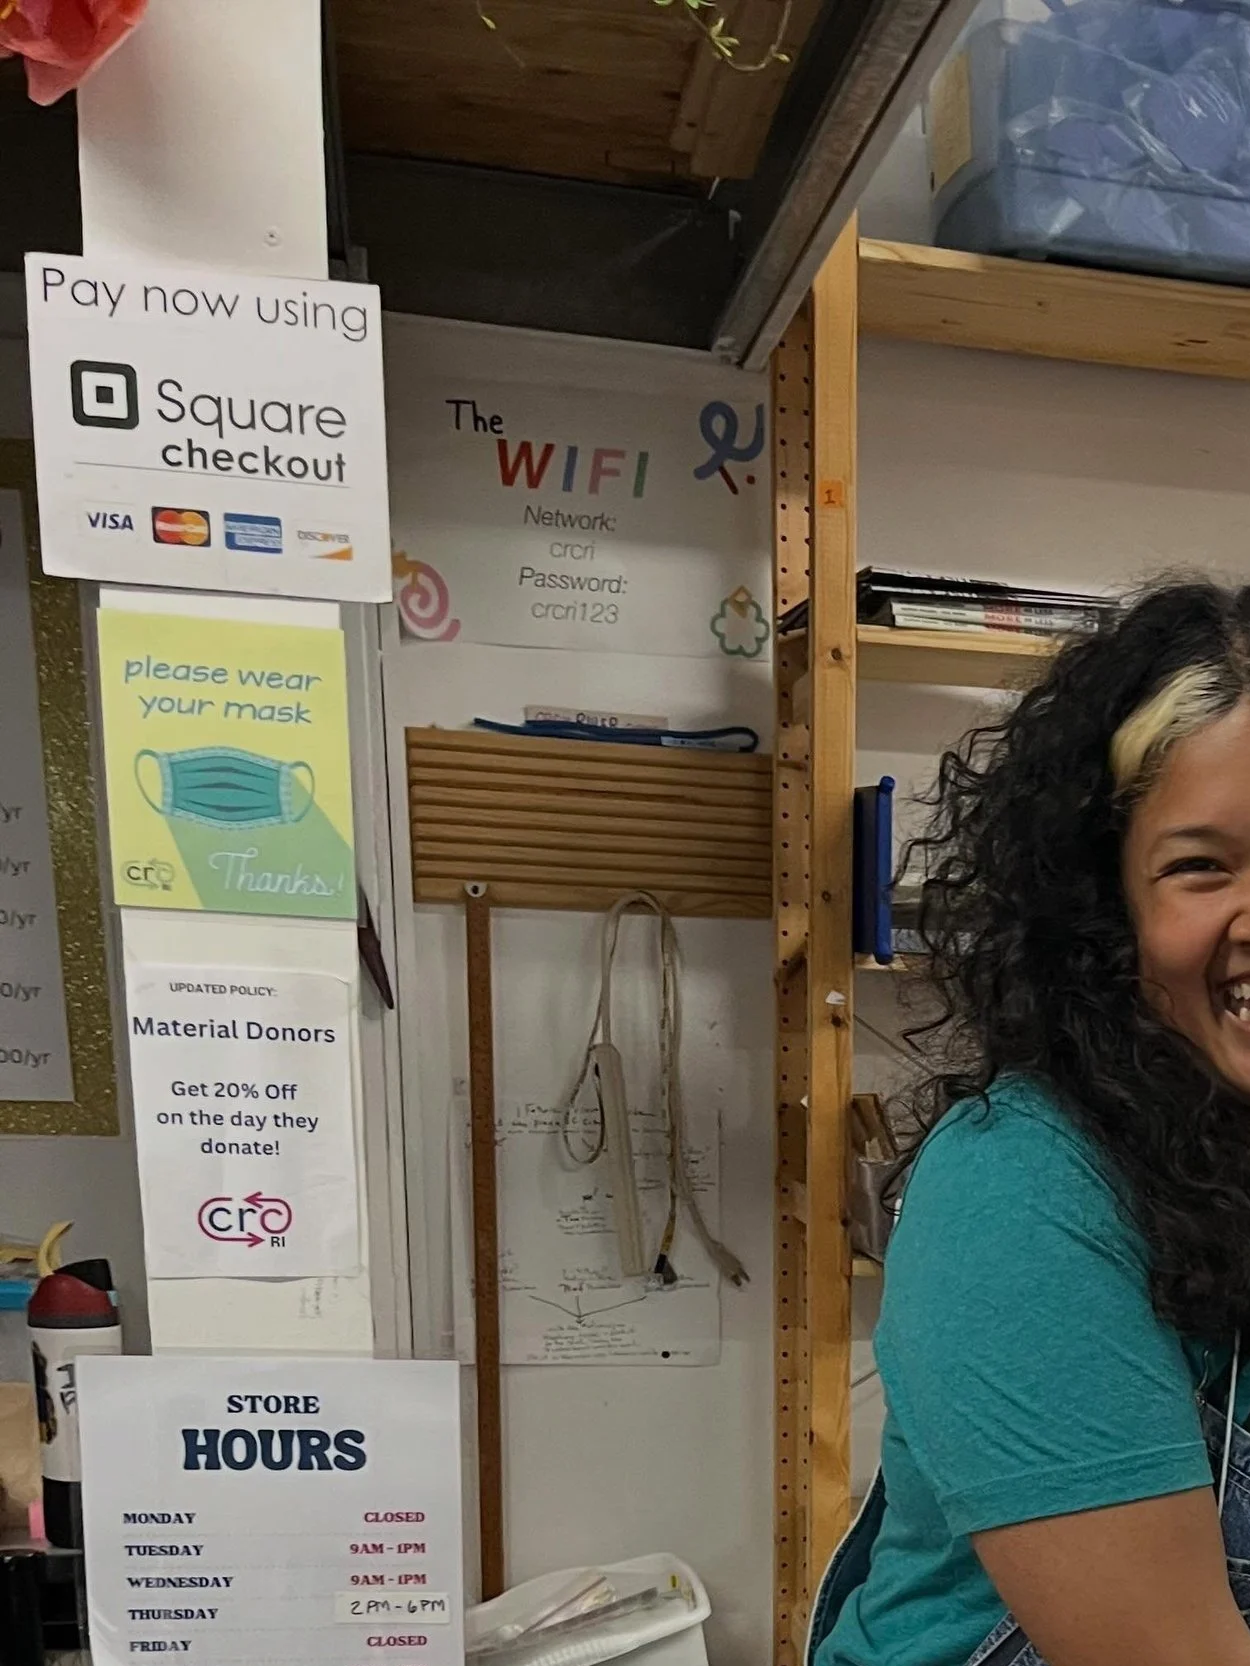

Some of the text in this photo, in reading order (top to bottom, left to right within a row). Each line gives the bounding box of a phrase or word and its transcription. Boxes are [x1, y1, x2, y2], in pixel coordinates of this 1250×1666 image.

[42, 267, 367, 342] Pay now using
[156, 378, 347, 439] Square
[446, 400, 503, 434] The
[161, 439, 346, 483] checkout
[497, 438, 649, 498] WIFI
[87, 511, 134, 531] VISA
[524, 505, 617, 532] Network:
[549, 541, 595, 560] crcri
[518, 567, 628, 595] Password:
[531, 602, 619, 624] crcri123
[124, 655, 322, 692] please wear
[138, 694, 312, 724] your mask
[169, 982, 227, 995] UPDATED
[132, 1016, 336, 1044] Material Donors
[171, 1081, 298, 1100] Get 20% Off
[156, 1110, 319, 1132] on the day they
[200, 1138, 280, 1156] donate!
[270, 1236, 286, 1248] RI
[226, 1394, 320, 1414] STORE
[181, 1428, 367, 1471] HOURS
[123, 1512, 197, 1525] MONDAY
[364, 1511, 425, 1523] CLOSED
[124, 1544, 204, 1557] TUESDAY
[349, 1543, 384, 1555] 9AM
[397, 1543, 426, 1554] 1PM
[127, 1576, 233, 1589] WEDNESDAY
[350, 1574, 385, 1586] 9AM
[398, 1574, 427, 1585] 1PM
[128, 1608, 219, 1622] THURSDAY
[129, 1640, 192, 1653] FRIDAY
[366, 1635, 428, 1647] CLOSED
